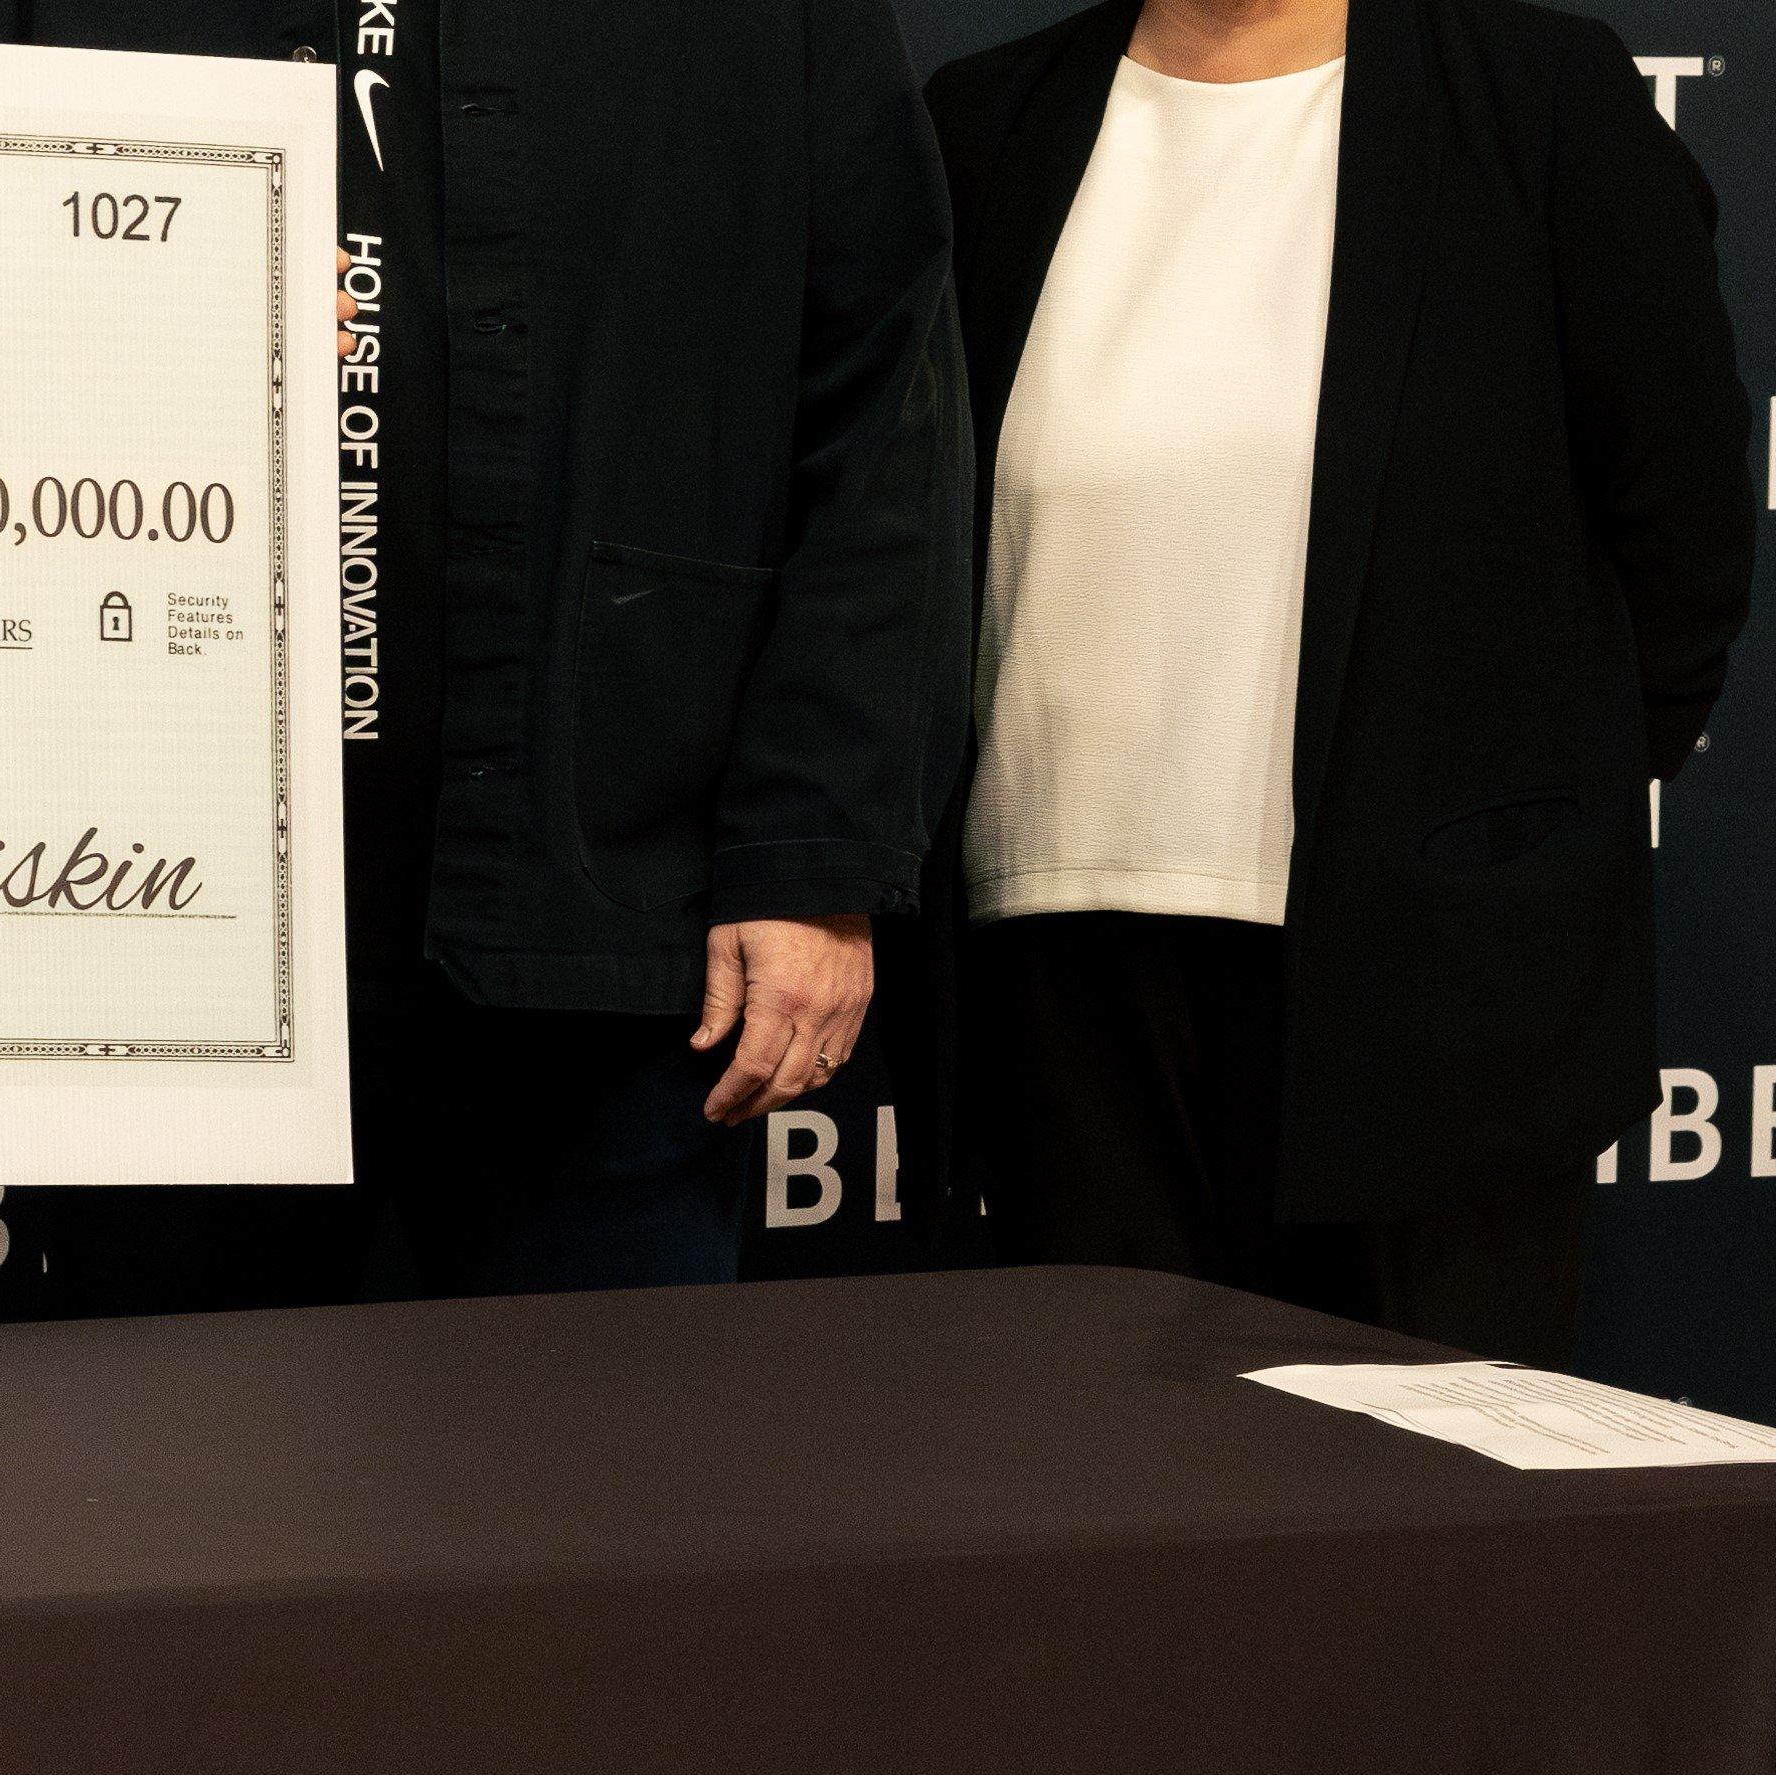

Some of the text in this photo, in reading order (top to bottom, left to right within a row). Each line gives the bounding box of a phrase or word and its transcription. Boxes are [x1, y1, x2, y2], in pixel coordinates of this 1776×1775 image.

[63, 191, 181, 242] 1027
[342, 405, 380, 469] OF
[167, 593, 228, 610] Security
[167, 609, 233, 624] Features
[340, 482, 380, 741] INNOVATION
[167, 625, 243, 640] Details on
